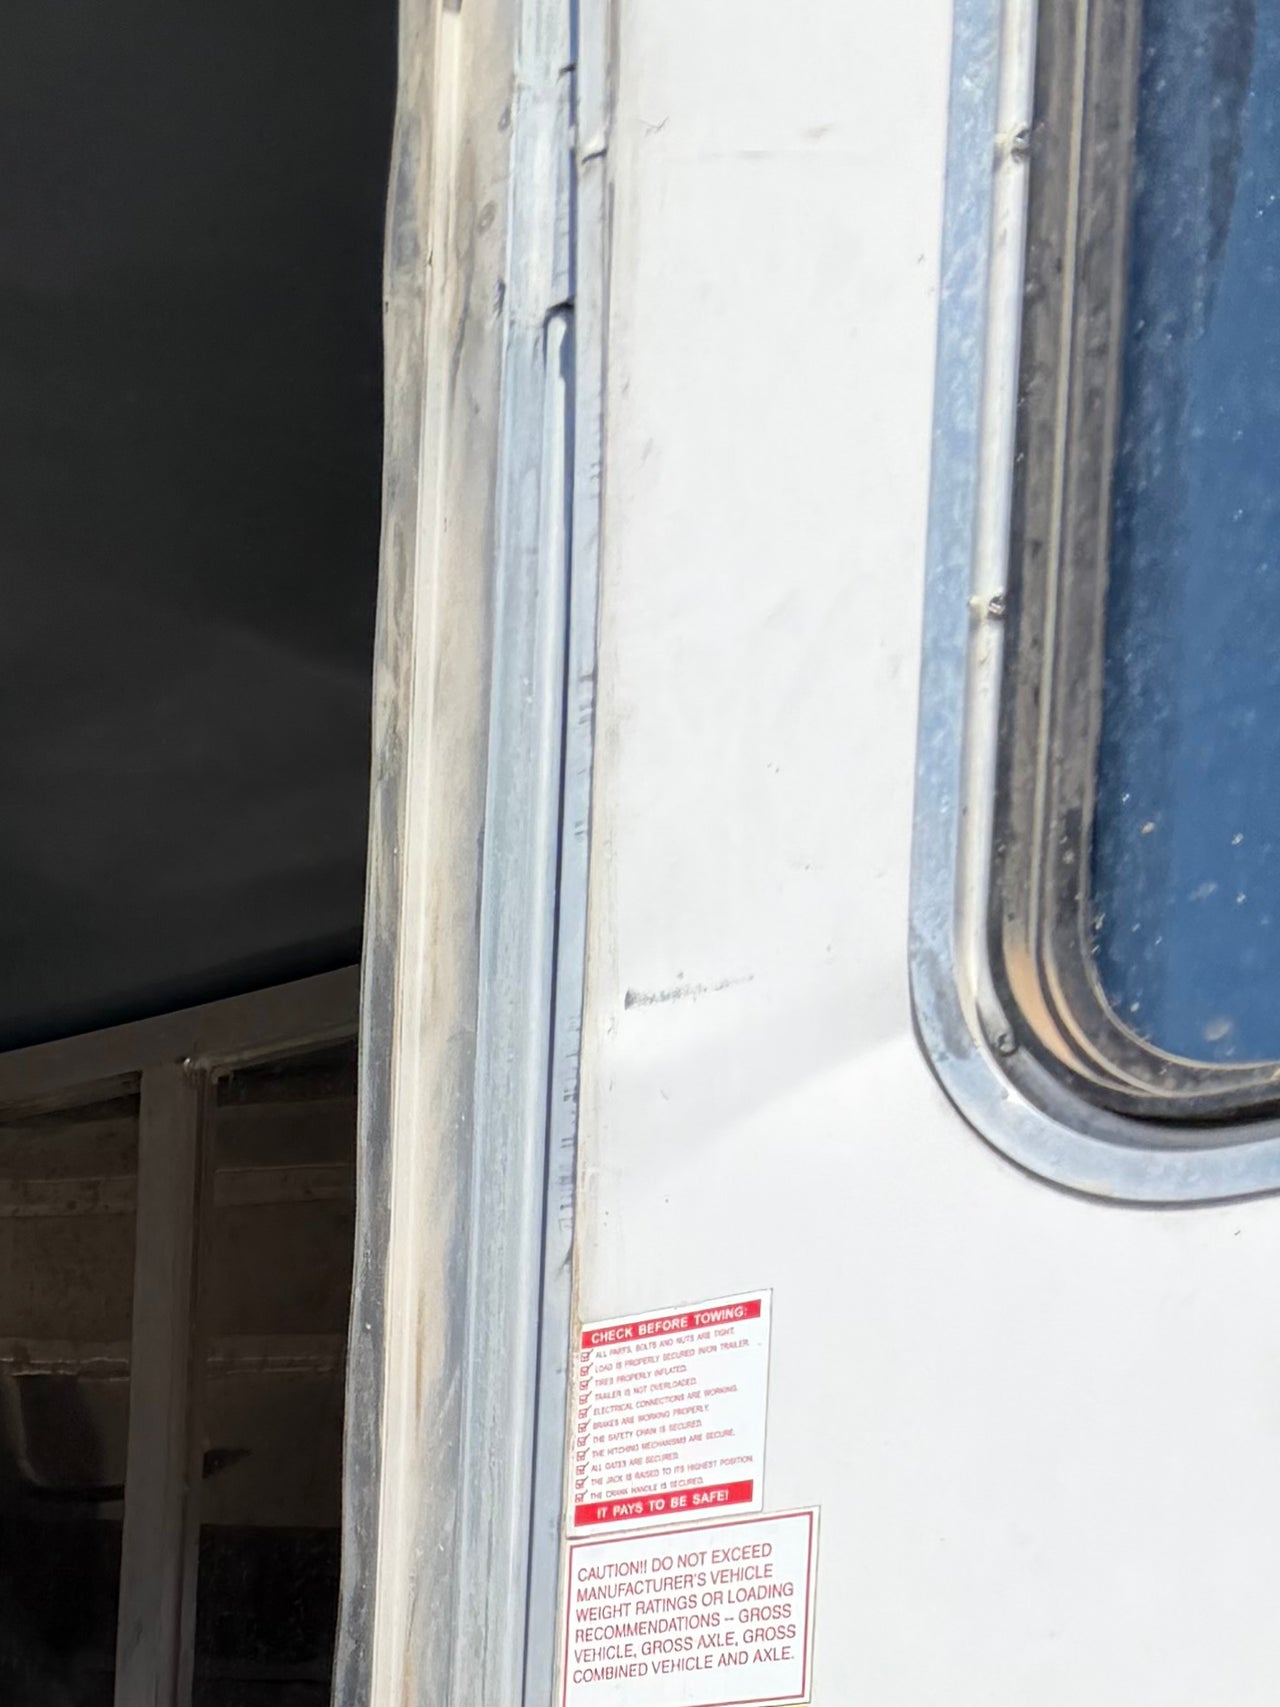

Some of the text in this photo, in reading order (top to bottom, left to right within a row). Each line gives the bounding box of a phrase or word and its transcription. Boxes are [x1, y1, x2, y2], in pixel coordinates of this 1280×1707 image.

[591, 1306, 747, 1344] CHECK BEFORE TOWING:
[659, 1338, 673, 1347] AND
[595, 1363, 613, 1373] LOAD
[624, 1355, 660, 1367] PROPERLY
[663, 1349, 695, 1361] SECURED
[616, 1371, 651, 1382] PROPERLY
[633, 1385, 647, 1394] NOT
[593, 1403, 633, 1416] ELECTRICAL
[593, 1419, 619, 1430] BRAKES
[593, 1435, 605, 1443] THE
[608, 1431, 633, 1441] SAFETY
[592, 1449, 604, 1457] THE
[597, 1489, 729, 1519] IT PAYS TO BE SAFE!
[577, 1542, 772, 1582] CAUTION!! DO NOT EXCEED
[576, 1563, 773, 1602] MANUFACTURER'S VEHICLE
[576, 1582, 794, 1623] WEIGHT RATINGS OR LOADING
[575, 1612, 720, 1643] RECOMMENDATIONS
[738, 1603, 791, 1623] GROSS
[574, 1624, 796, 1663] VEHICLE, GROSS AXLE, GROSS
[573, 1646, 794, 1684] COMBINED VEHICLE AND AXLE.
